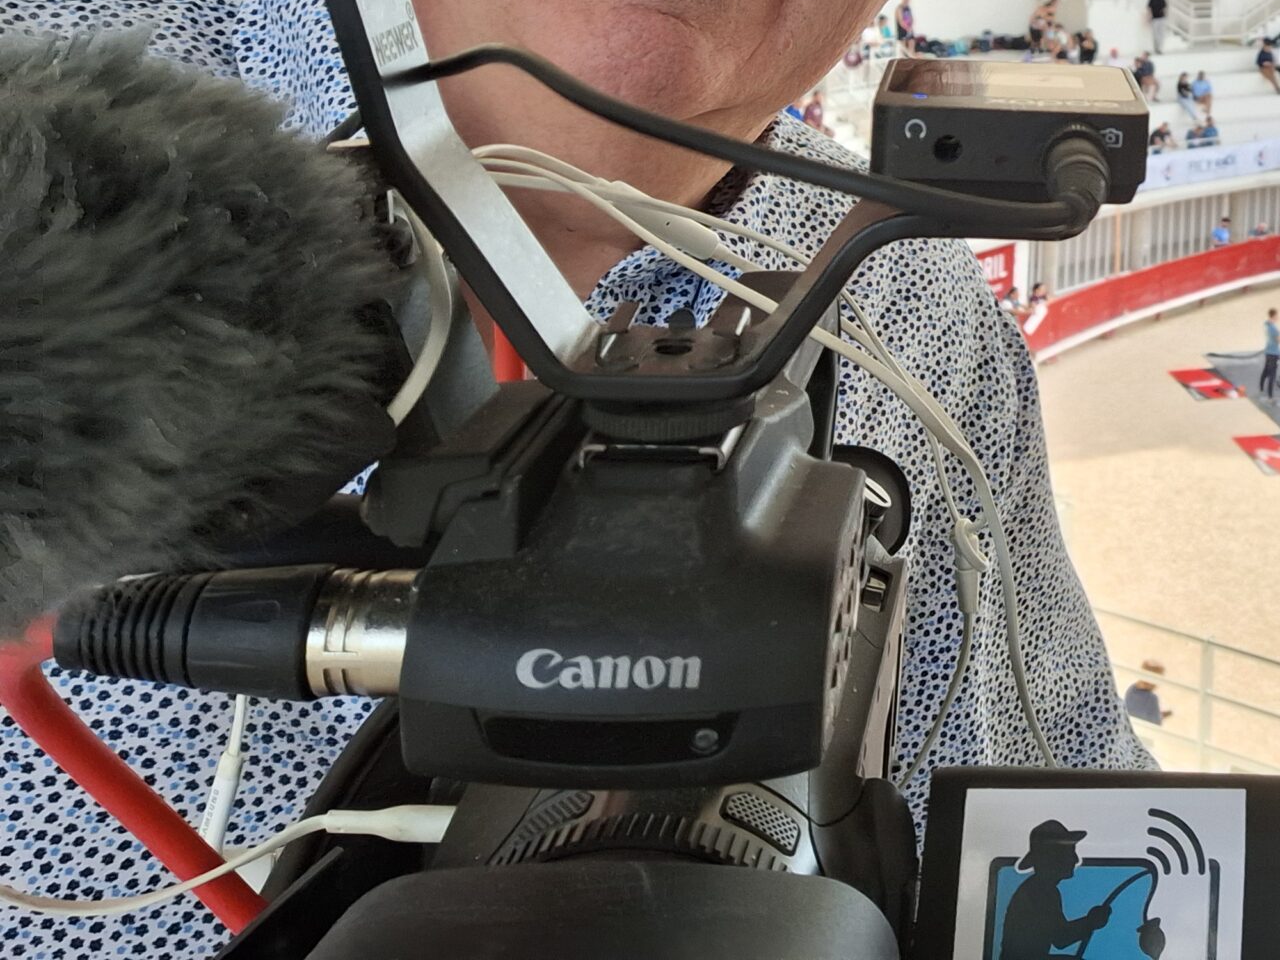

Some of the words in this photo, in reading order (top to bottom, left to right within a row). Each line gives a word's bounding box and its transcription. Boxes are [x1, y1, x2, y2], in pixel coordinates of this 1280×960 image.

[979, 254, 1008, 281] RIL
[515, 648, 702, 690] Canon
[202, 788, 220, 837] AMSUNG
